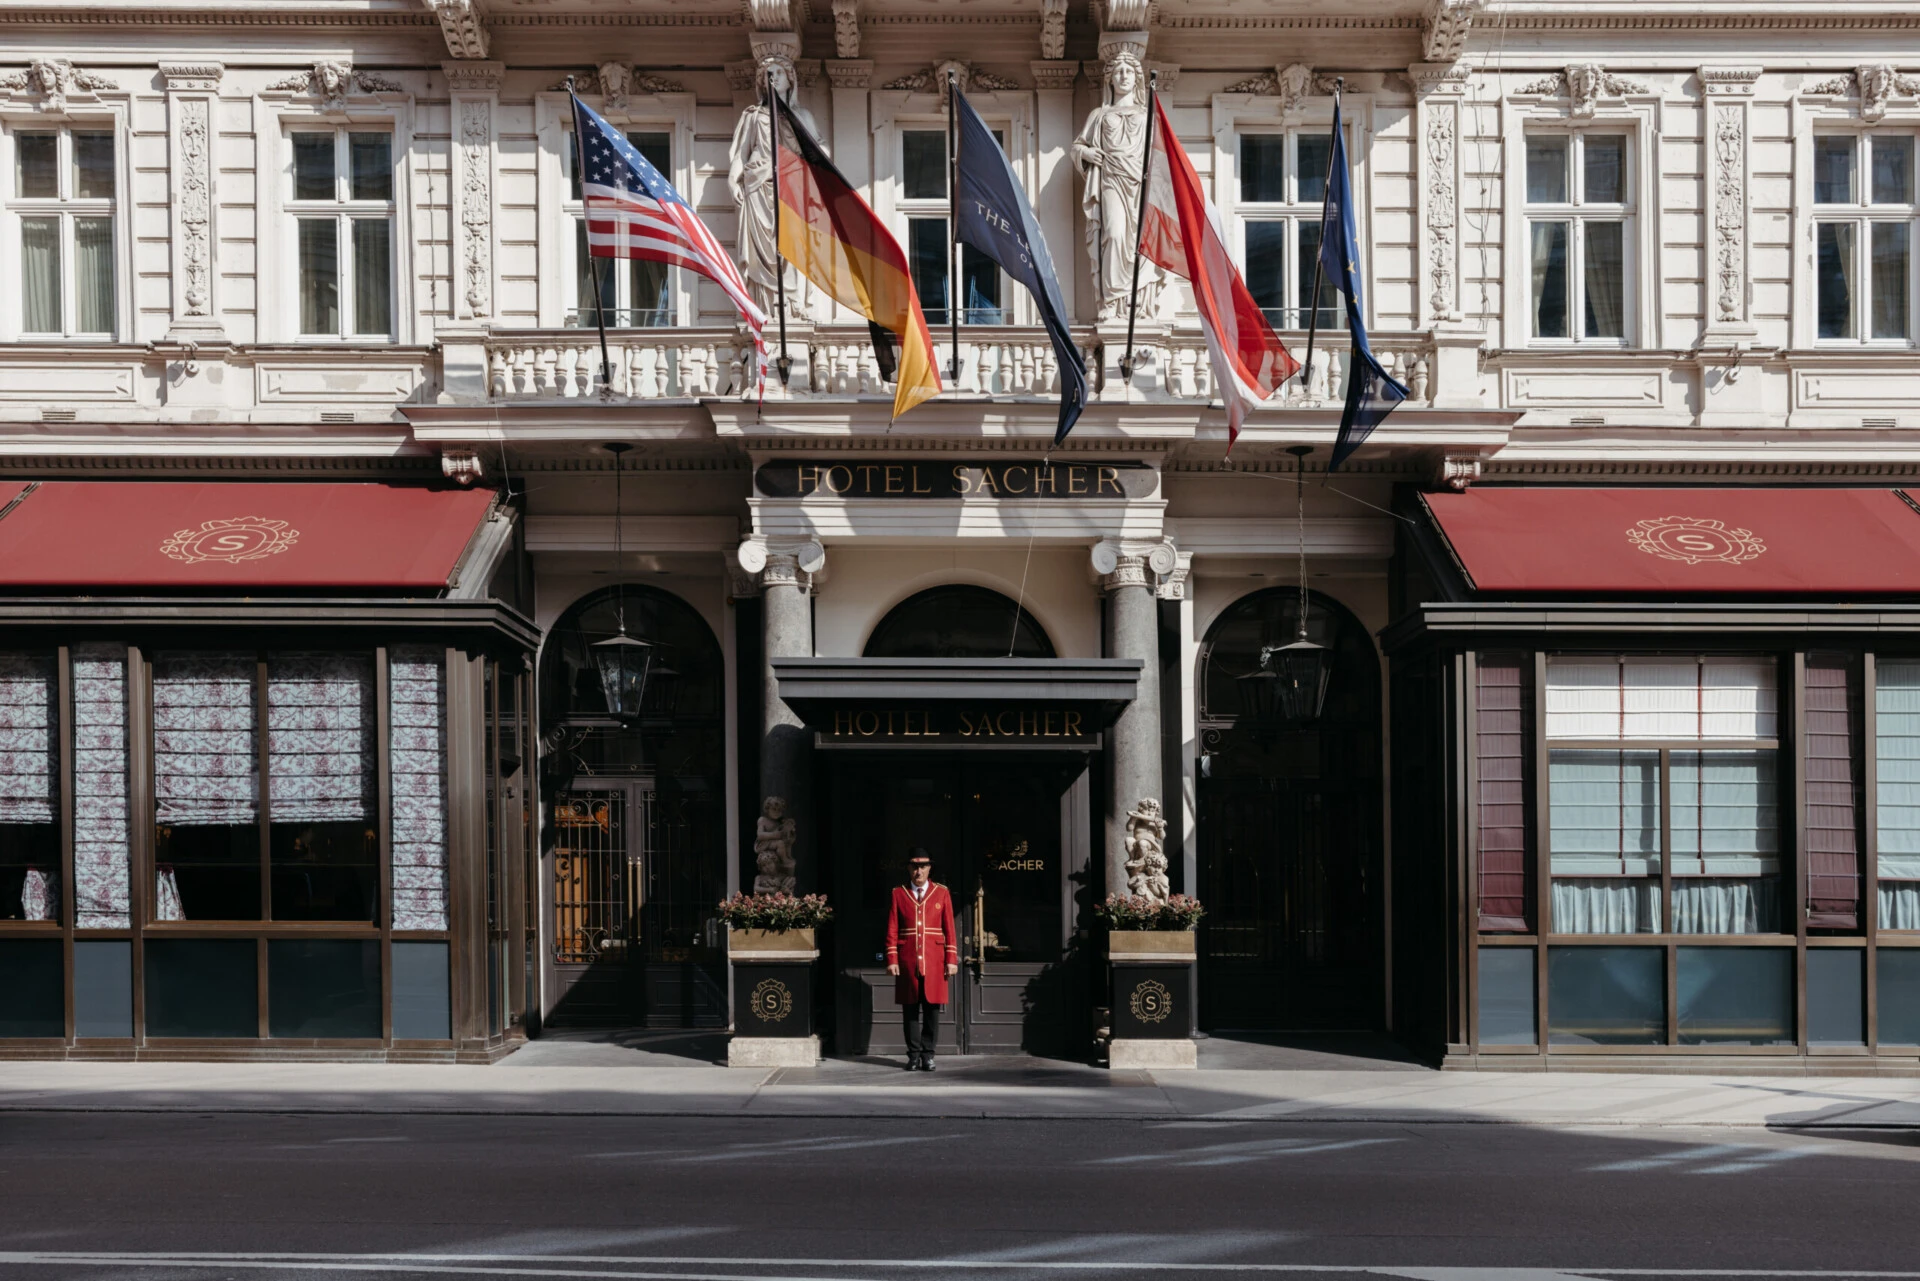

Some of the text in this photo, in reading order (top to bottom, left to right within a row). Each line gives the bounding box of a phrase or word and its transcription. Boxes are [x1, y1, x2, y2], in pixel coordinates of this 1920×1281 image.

[975, 201, 1010, 234] THE
[797, 465, 1122, 494] HOTEL SACHER
[210, 535, 250, 551] S
[1676, 534, 1715, 551] S
[834, 710, 1083, 736] HOTEL SACHER
[766, 994, 777, 1009] S
[1145, 995, 1157, 1011] S
